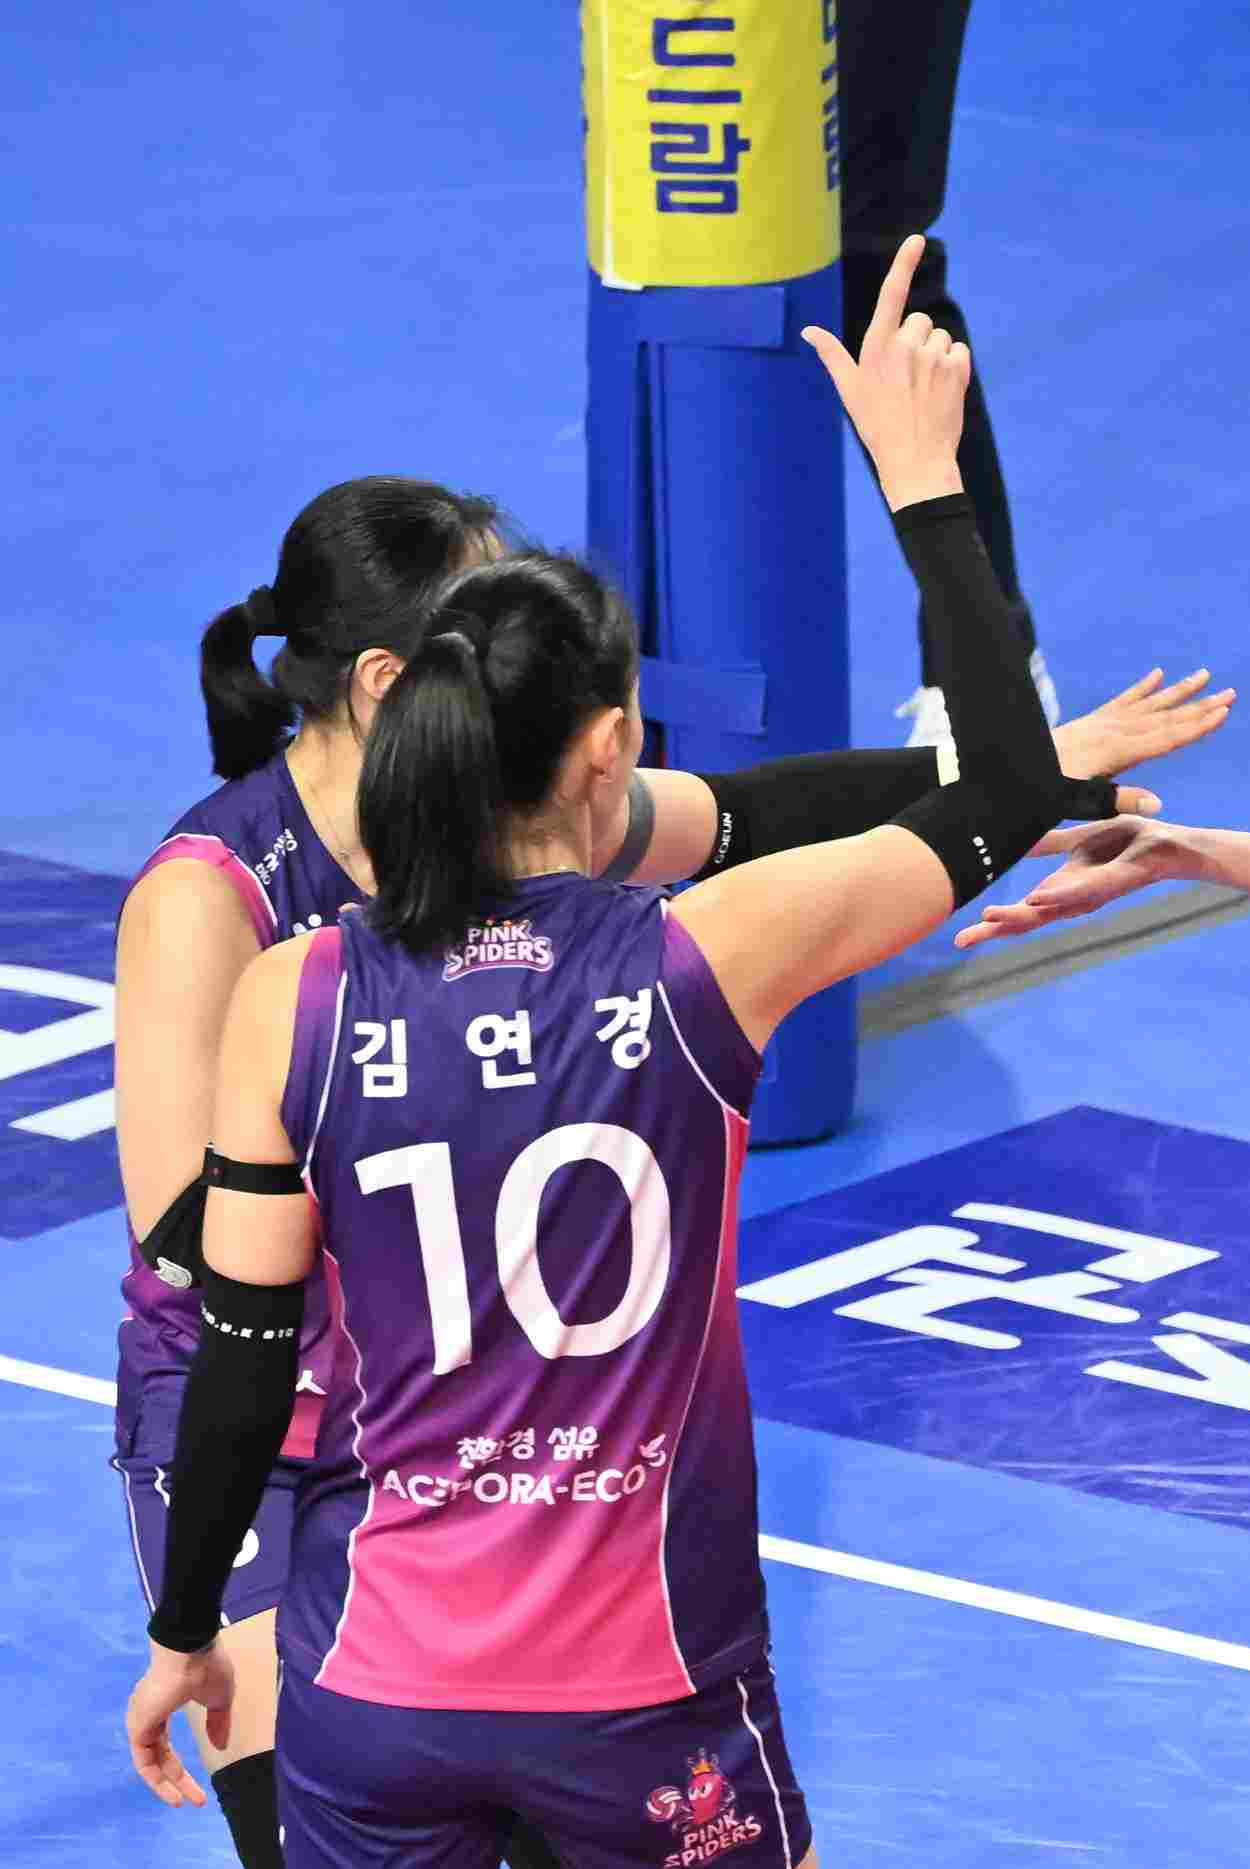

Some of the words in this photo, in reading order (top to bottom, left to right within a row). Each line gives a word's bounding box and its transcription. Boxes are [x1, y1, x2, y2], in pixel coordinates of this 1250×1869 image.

[467, 919, 530, 944] PINK
[445, 940, 551, 975] SPIDERS
[354, 1122, 672, 1375] 10
[663, 1815, 762, 1868] SPIDERS
[683, 1808, 739, 1848] PINK
